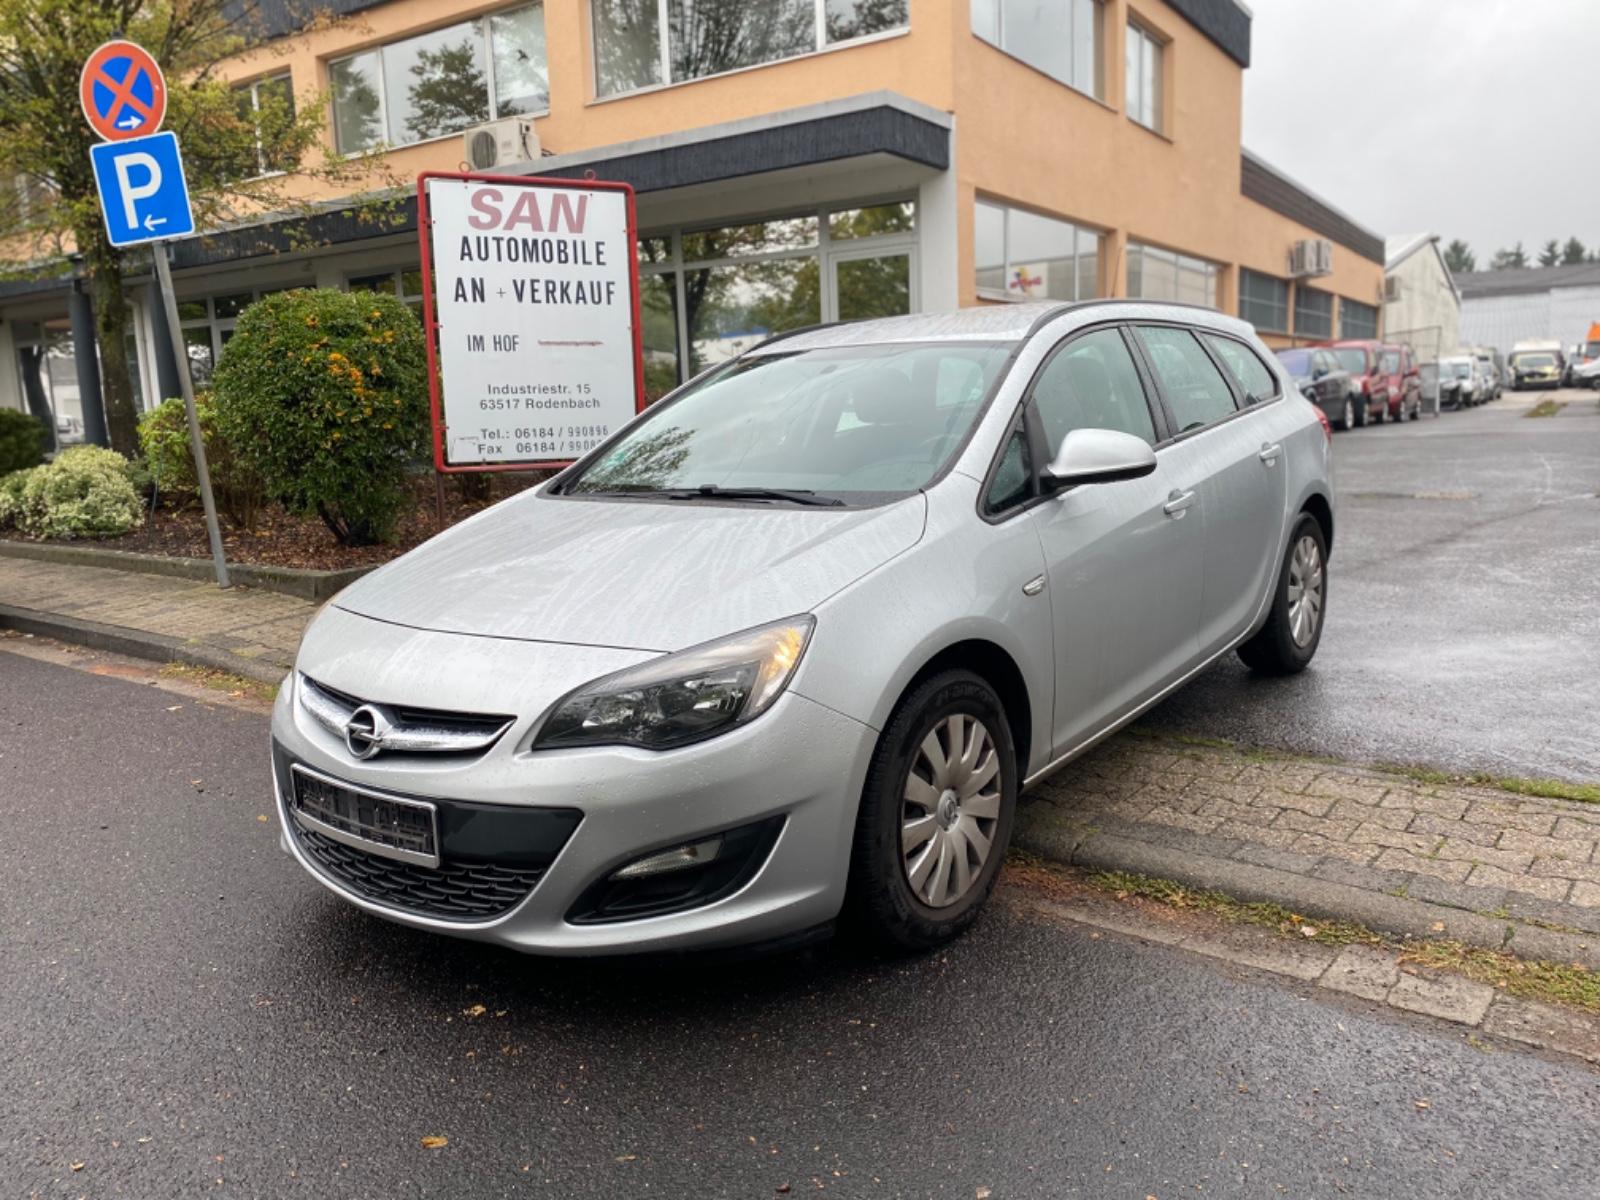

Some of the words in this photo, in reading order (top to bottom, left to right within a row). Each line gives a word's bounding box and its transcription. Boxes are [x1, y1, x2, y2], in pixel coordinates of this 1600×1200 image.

[113, 152, 162, 230] P
[467, 188, 588, 234] SAN
[460, 235, 607, 266] AUTOMOBILE
[454, 277, 486, 303] AN
[513, 279, 616, 306] VERKAUF
[467, 334, 485, 352] IM
[493, 334, 520, 352] HOF
[487, 384, 572, 395] Industriestr.
[577, 383, 591, 394] 15
[480, 400, 520, 410] 63517
[525, 398, 600, 409] Rodenbach
[515, 427, 554, 438] 06184
[478, 444, 503, 454] Fax
[516, 442, 555, 453] 06184
